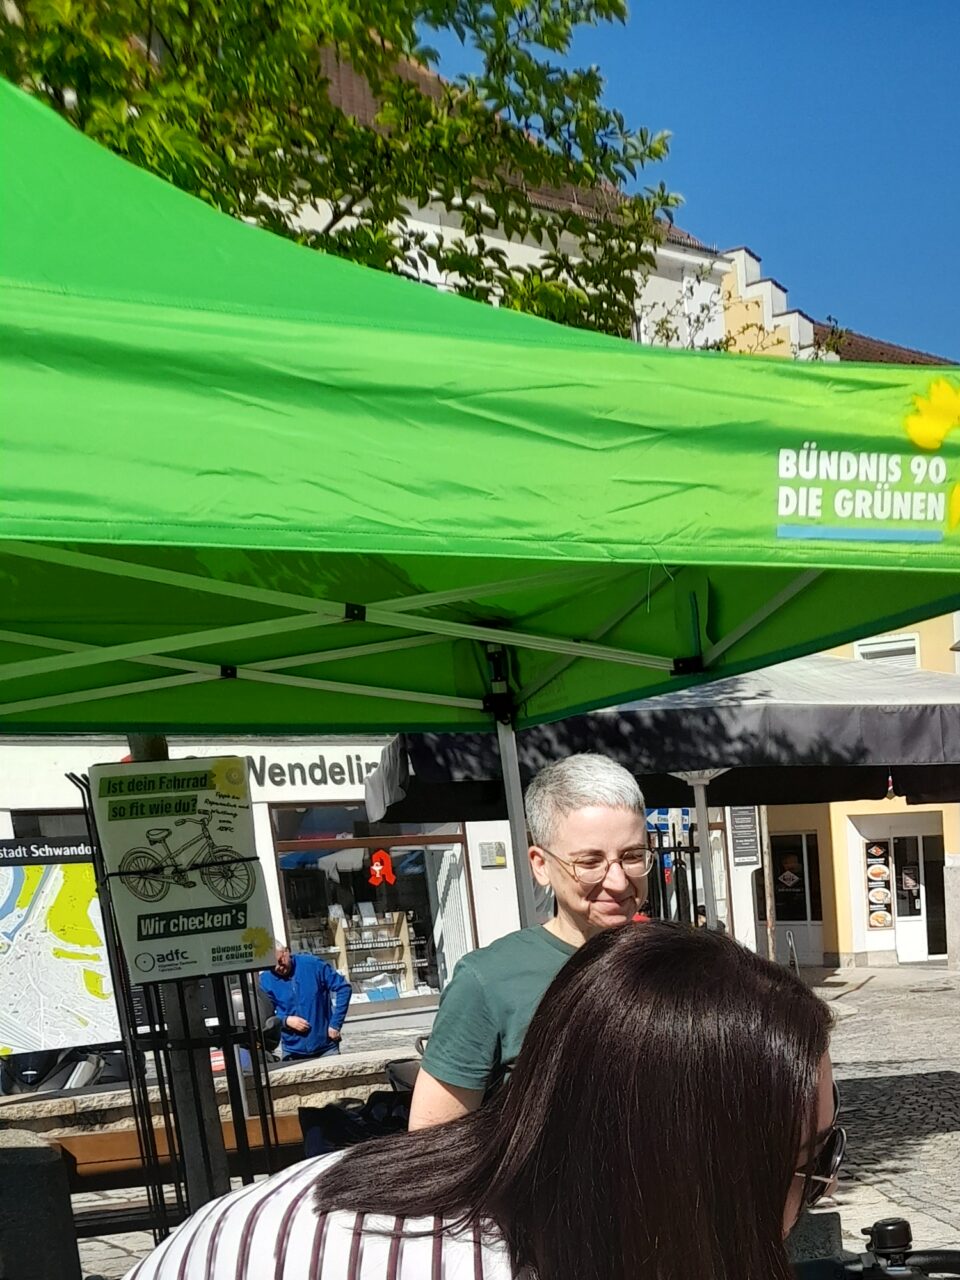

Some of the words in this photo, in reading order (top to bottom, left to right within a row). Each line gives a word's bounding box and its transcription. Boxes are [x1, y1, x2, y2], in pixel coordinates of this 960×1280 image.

[778, 441, 902, 483] BÜNDNIS
[909, 456, 947, 484] 90
[778, 486, 823, 517] DIE
[834, 482, 945, 521] GRÜNEN
[107, 777, 125, 794] Ist
[127, 777, 156, 792] dein
[158, 774, 208, 790] Fahrrad
[111, 805, 126, 818] so
[129, 800, 146, 816] fit
[150, 800, 173, 815] wie
[174, 798, 198, 813] du?
[140, 916, 166, 936] Wir
[156, 949, 189, 963] adfc
